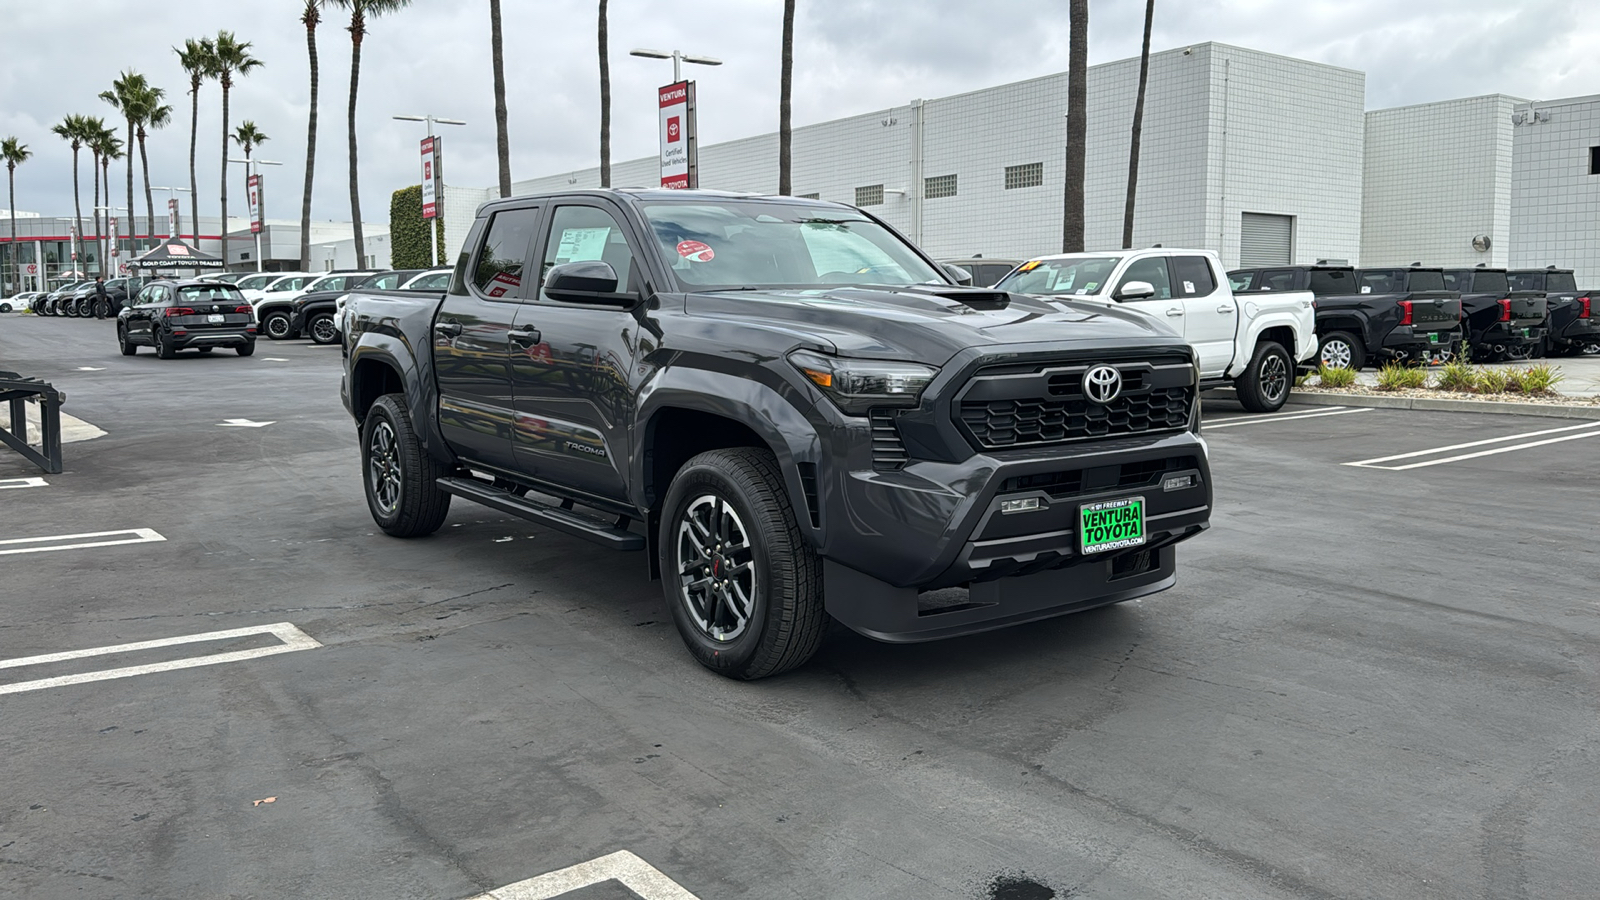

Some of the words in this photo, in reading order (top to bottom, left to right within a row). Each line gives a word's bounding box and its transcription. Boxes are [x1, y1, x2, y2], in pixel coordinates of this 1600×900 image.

[660, 88, 686, 102] VENTURA
[665, 147, 682, 157] Certified
[668, 180, 687, 189] TOYOTA
[565, 440, 606, 457] TACOMA
[1103, 500, 1128, 509] FREEWAY
[1083, 506, 1139, 528] VENTURA
[1085, 520, 1138, 543] TOYOTA
[1084, 537, 1143, 553] VENTURATOYOTA.COM
